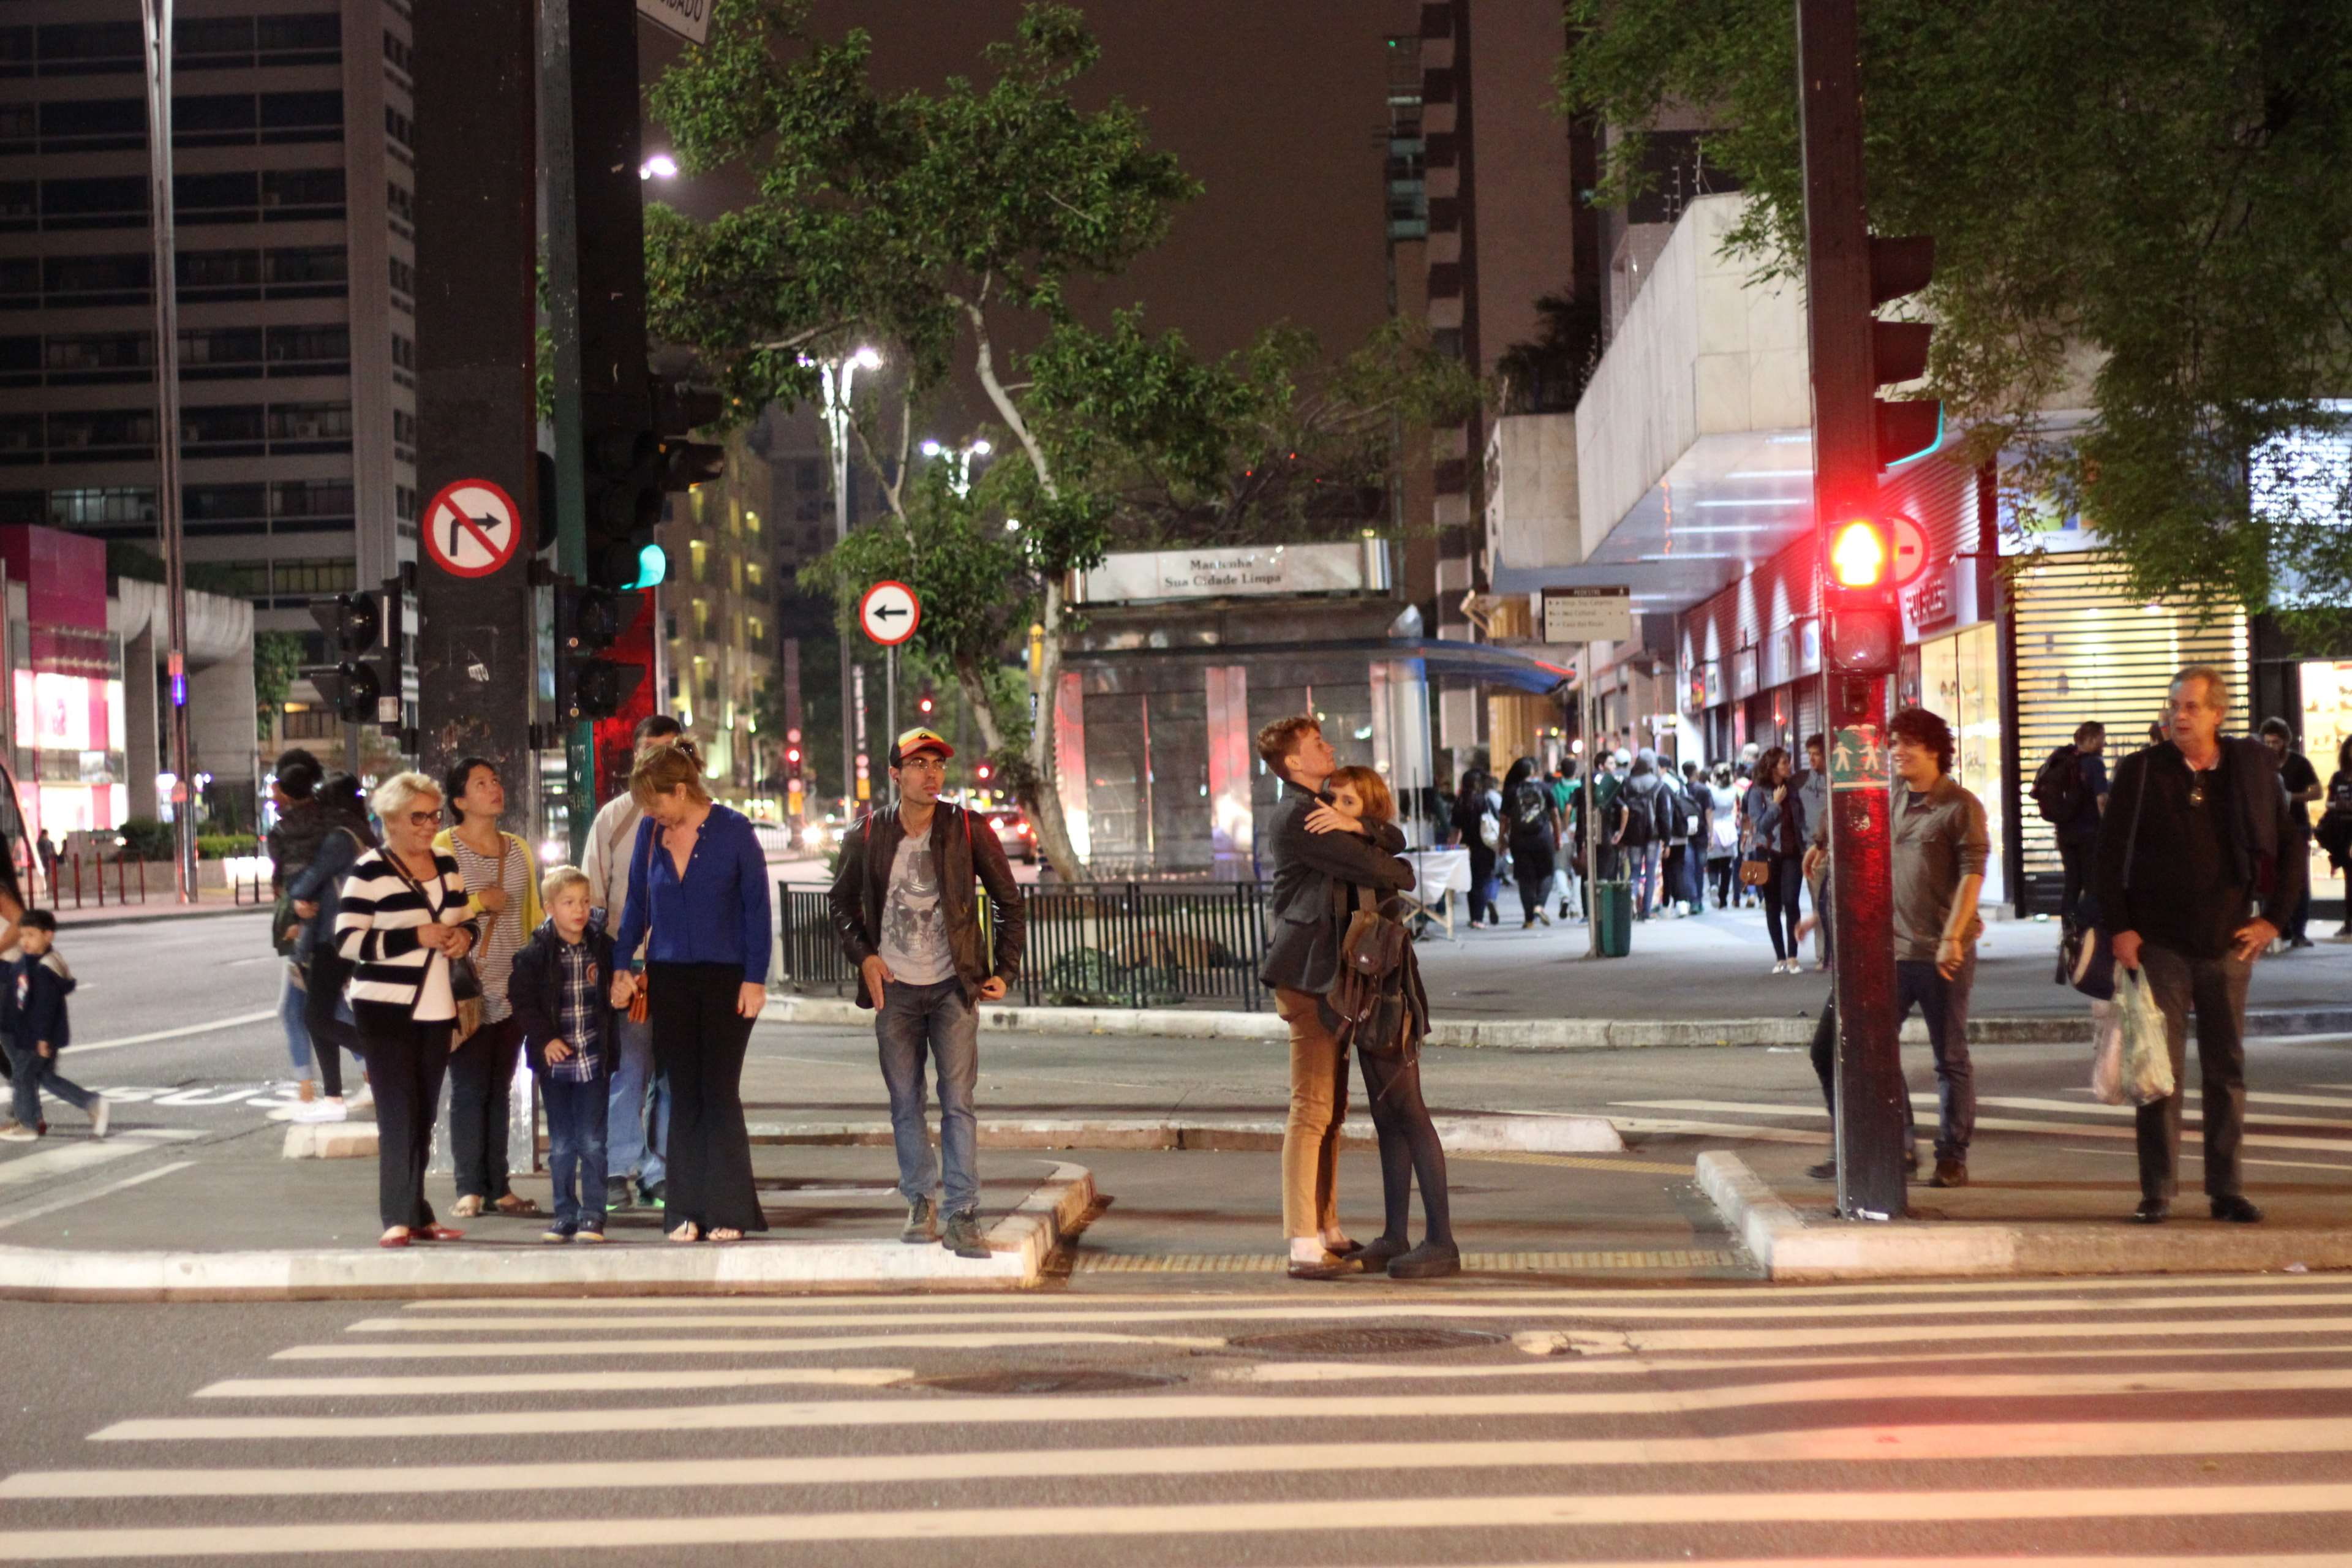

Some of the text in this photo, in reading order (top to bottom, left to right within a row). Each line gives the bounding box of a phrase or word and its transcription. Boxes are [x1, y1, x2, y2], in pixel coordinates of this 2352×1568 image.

[1190, 558, 1253, 570] Mantenha
[1165, 572, 1281, 587] Sua Cidade Limpa
